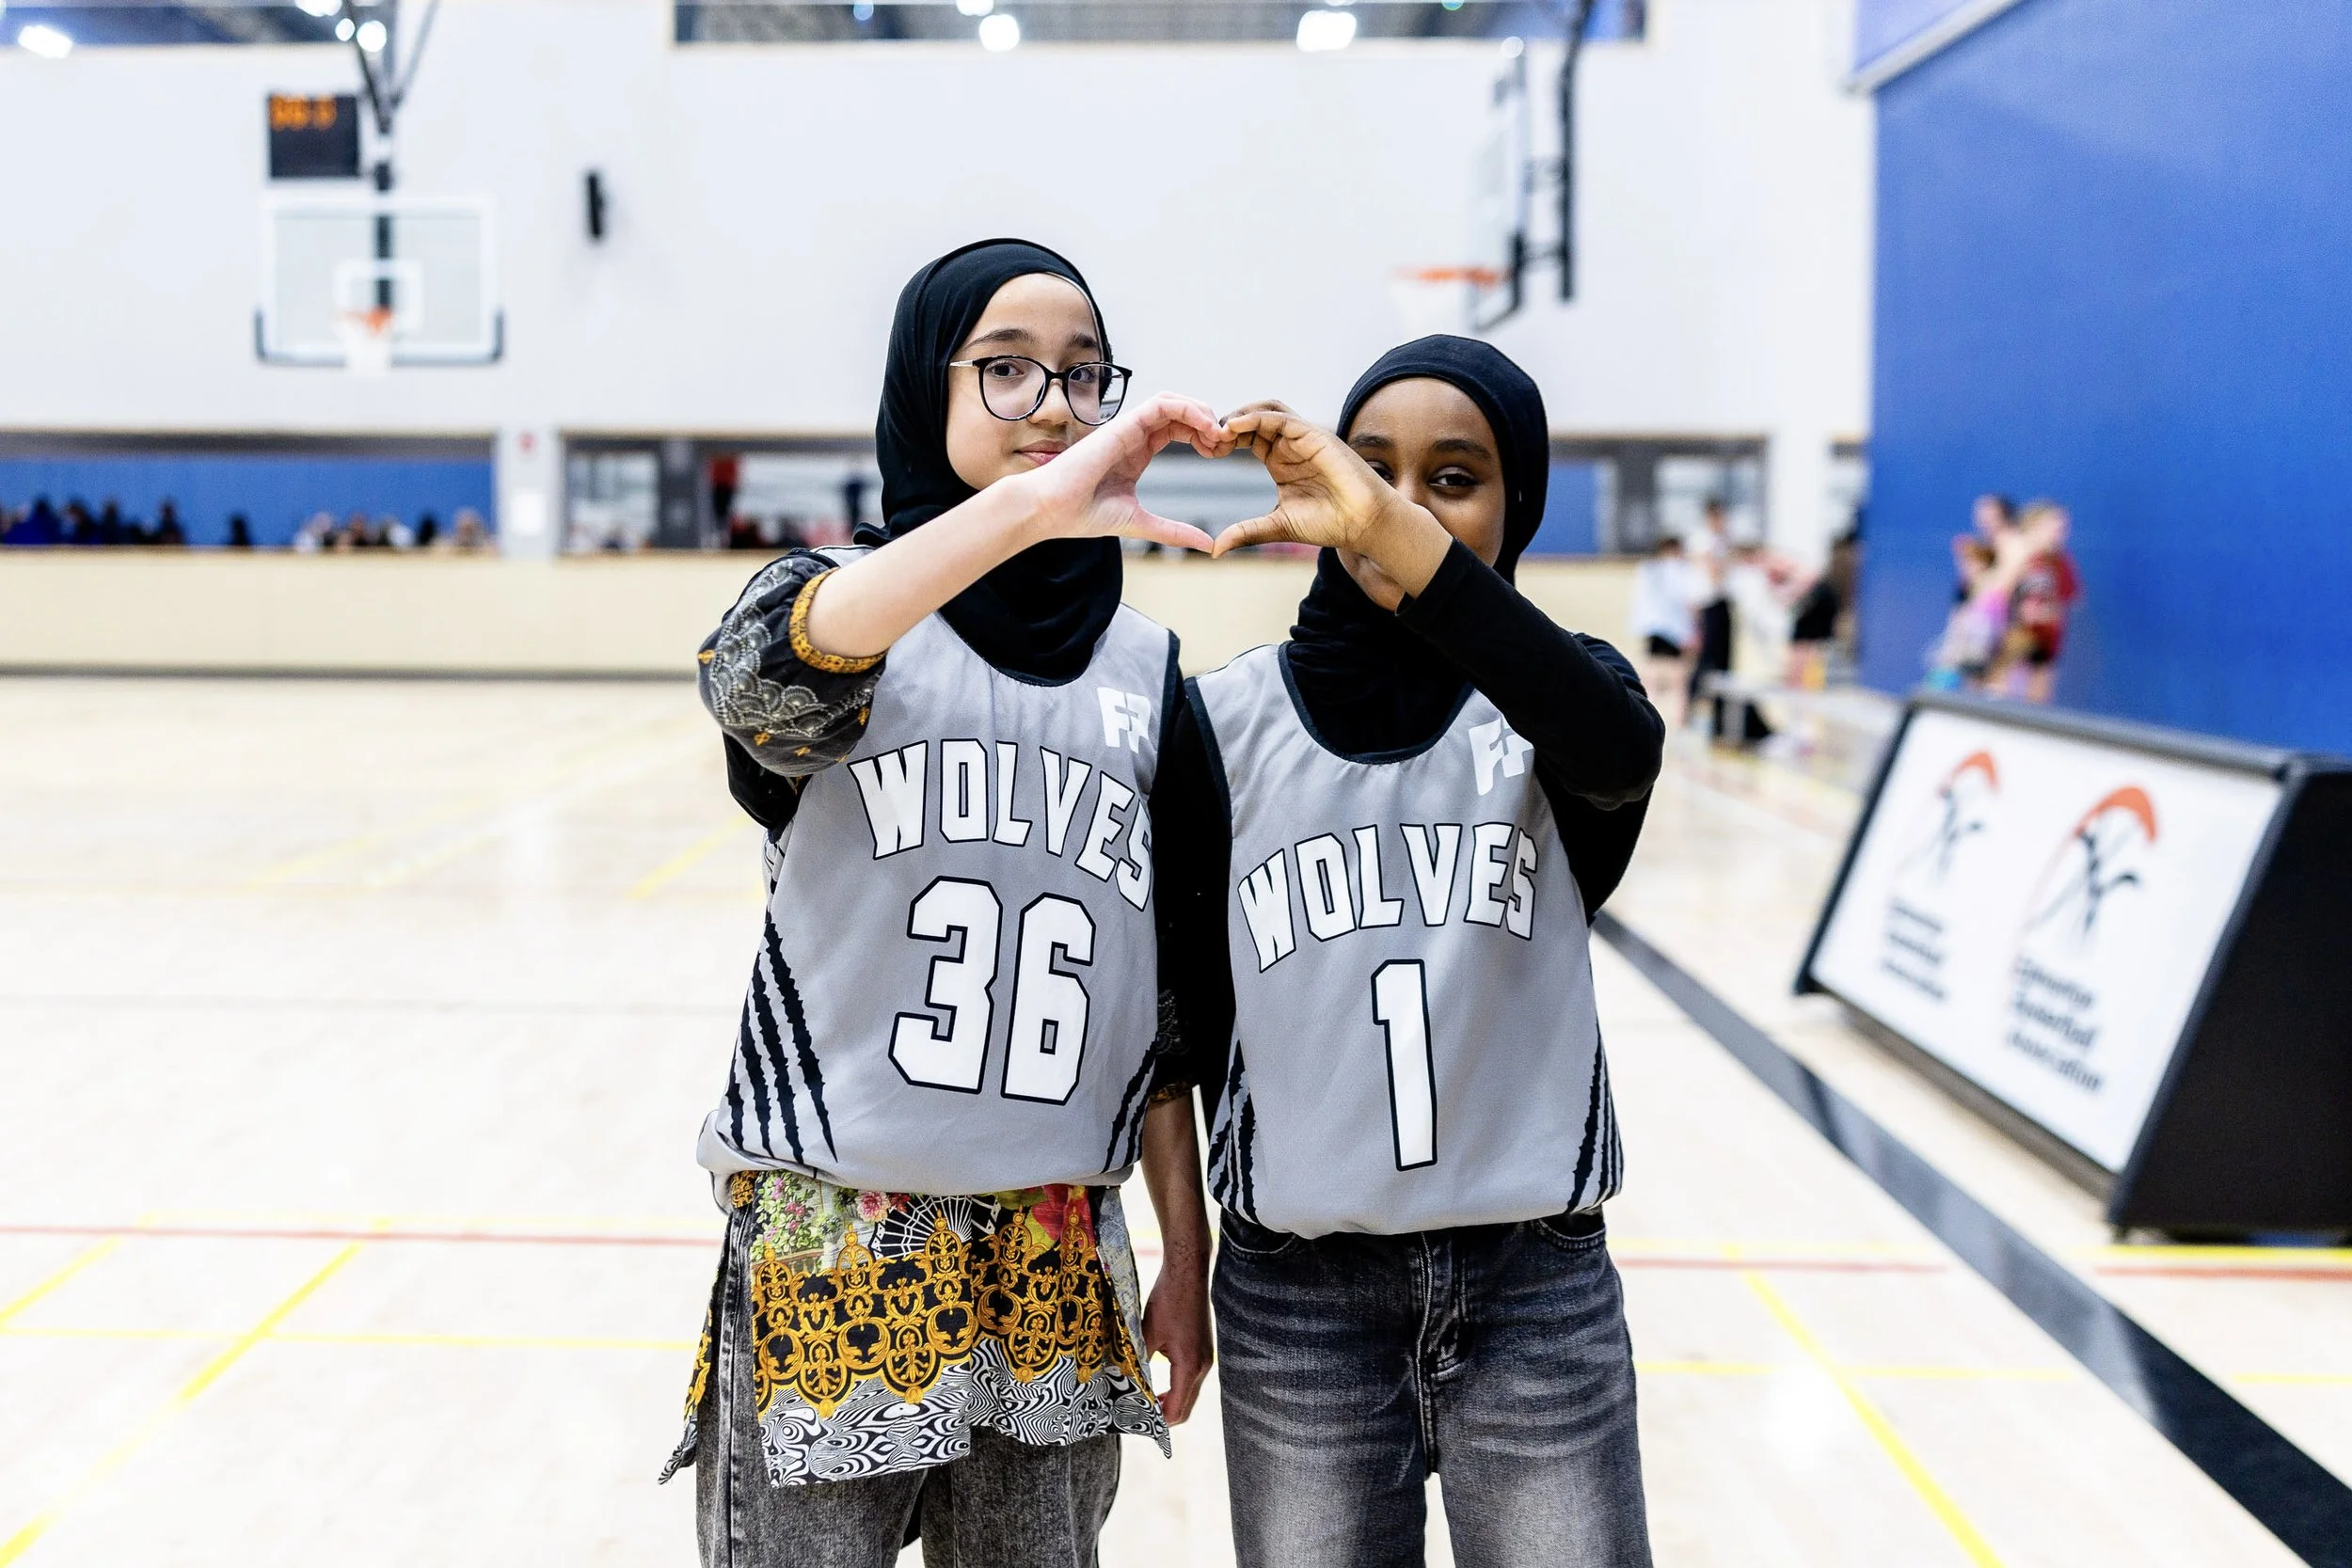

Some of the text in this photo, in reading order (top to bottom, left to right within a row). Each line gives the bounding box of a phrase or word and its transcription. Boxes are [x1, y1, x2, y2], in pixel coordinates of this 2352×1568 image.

[847, 738, 1152, 911] WOLVES
[1237, 822, 1538, 974] WOLVES
[888, 875, 1096, 1106] 36
[1371, 958, 1438, 1172] 1
